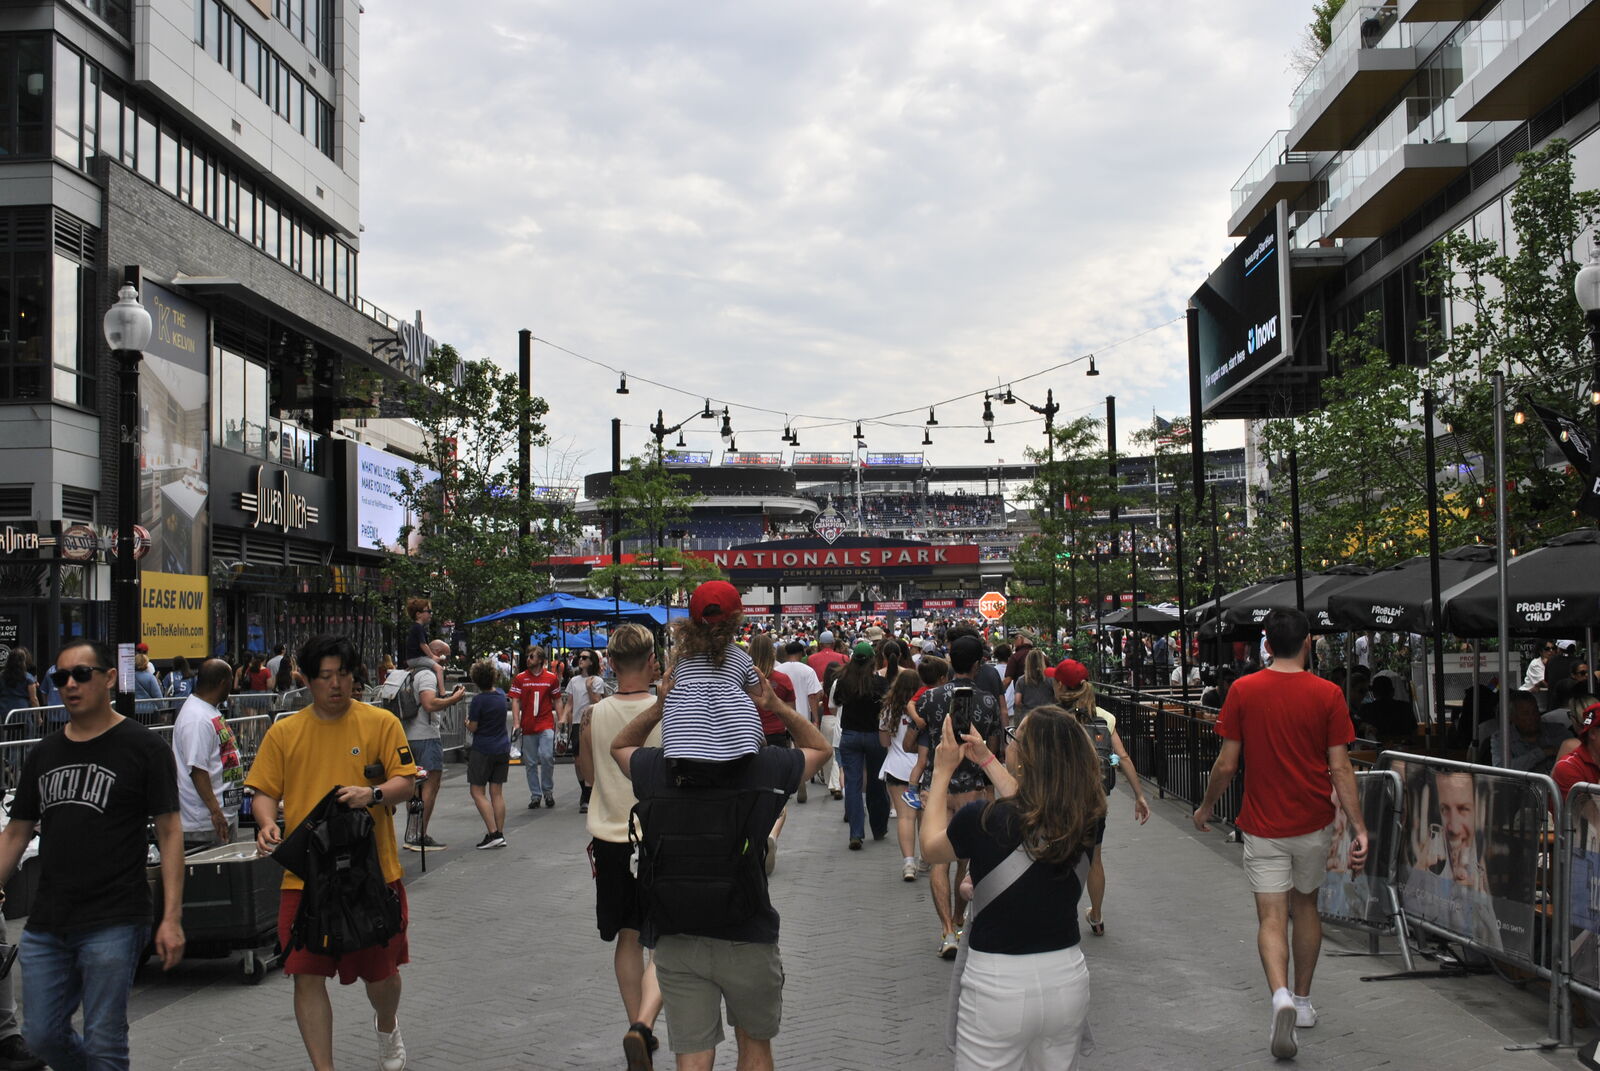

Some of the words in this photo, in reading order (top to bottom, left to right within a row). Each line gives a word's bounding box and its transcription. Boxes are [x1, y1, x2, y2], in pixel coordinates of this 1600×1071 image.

[172, 310, 186, 328] THE
[172, 331, 195, 352] KELVIN
[1255, 316, 1277, 350] Inova
[361, 459, 374, 474] WHAT
[374, 464, 382, 478] WILL
[382, 467, 391, 480] THE
[361, 477, 374, 491] MAKE
[374, 480, 382, 494] YOU
[253, 464, 283, 529] SILVER
[361, 524, 379, 539] PHOENIX
[713, 550, 872, 567] NATIONALS
[881, 548, 949, 564] PARK
[143, 588, 177, 609] LEASE
[179, 590, 204, 610] NOW
[981, 600, 1004, 612] STOP
[1516, 601, 1562, 613] PROBLEM
[1371, 605, 1401, 617] PROBLEM
[143, 622, 204, 637] LiveTheKelvin.com
[180, 682, 187, 691] 5
[533, 691, 540, 717] 1
[39, 768, 81, 814] BLACK
[82, 763, 115, 809] CAT
[1510, 921, 1525, 934] SMITH
